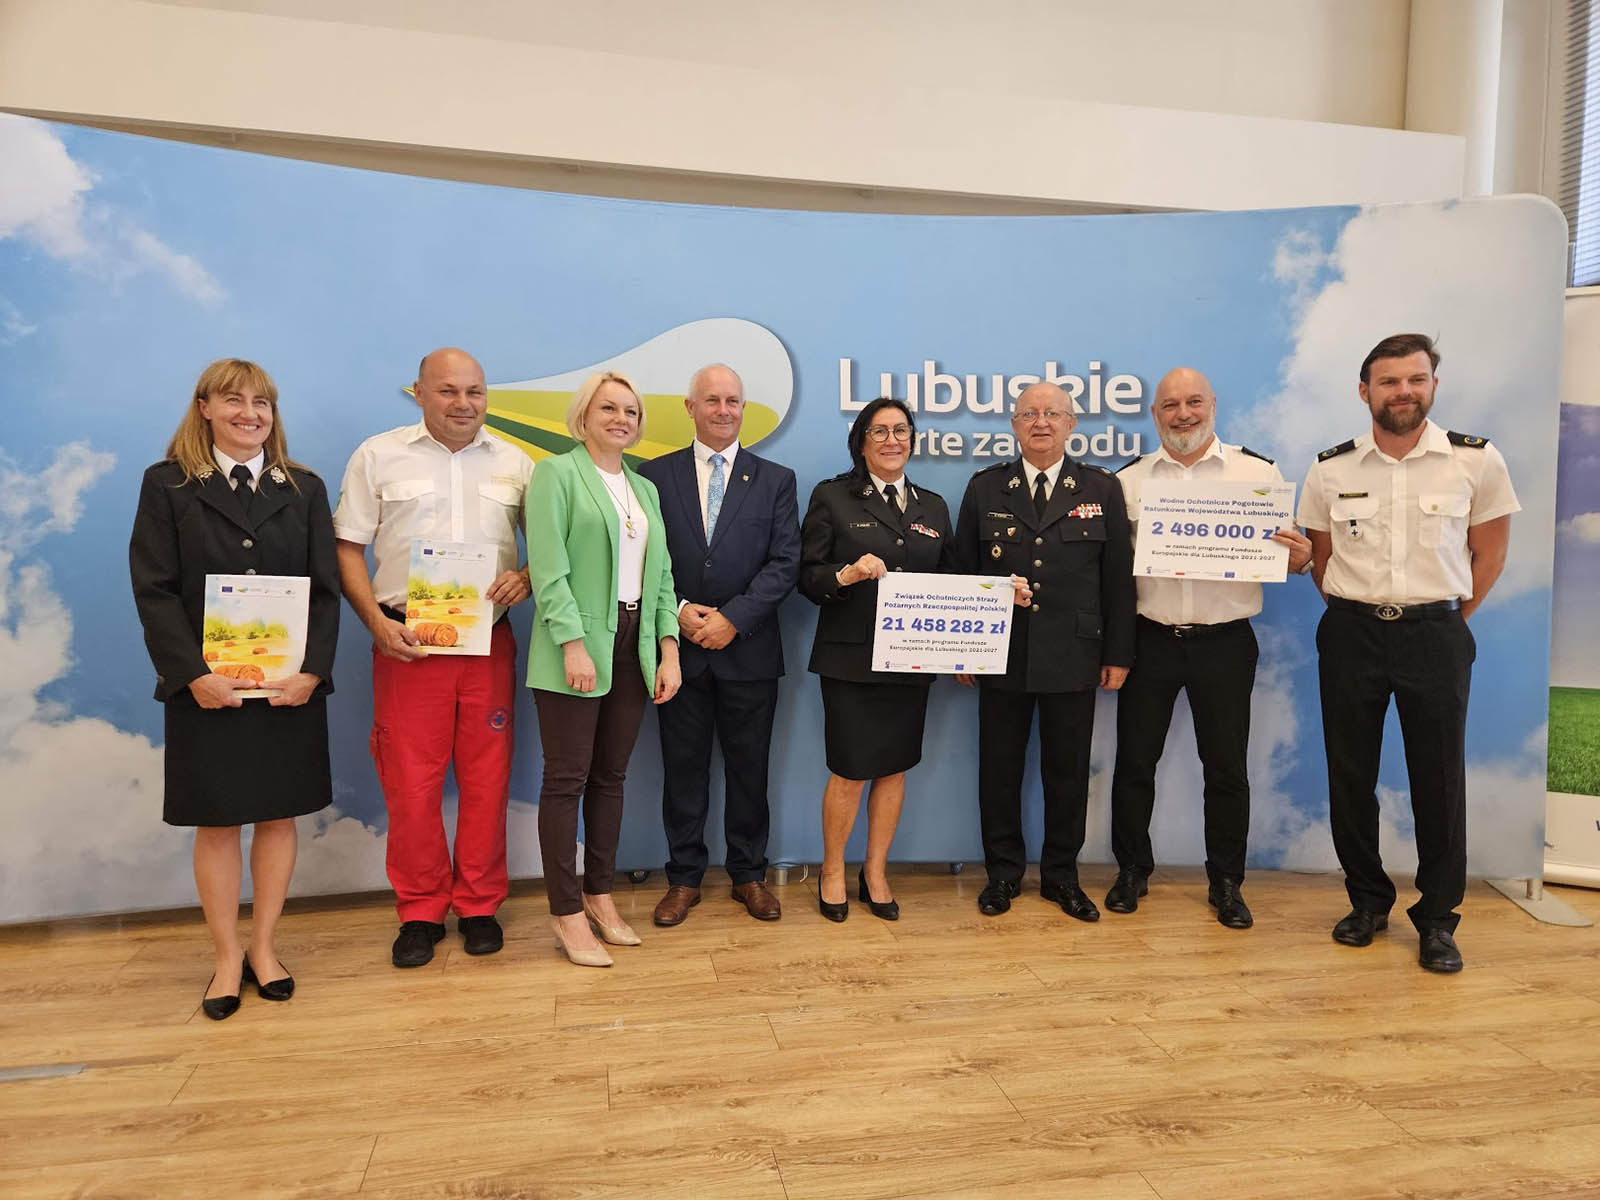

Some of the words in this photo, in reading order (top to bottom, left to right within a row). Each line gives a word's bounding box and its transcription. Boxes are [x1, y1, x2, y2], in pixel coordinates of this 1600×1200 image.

[972, 425, 1141, 457] zaodu
[1186, 498, 1230, 506] Ochotnicze
[1243, 510, 1289, 518] Lubuskiego
[1152, 521, 1164, 535] 2
[1170, 522, 1209, 537] 496
[1214, 523, 1255, 539] 000
[926, 593, 975, 602] Ochotniczych
[882, 616, 905, 631] 21
[911, 617, 946, 632] 458
[950, 619, 985, 634] 282
[990, 620, 1007, 634] zł
